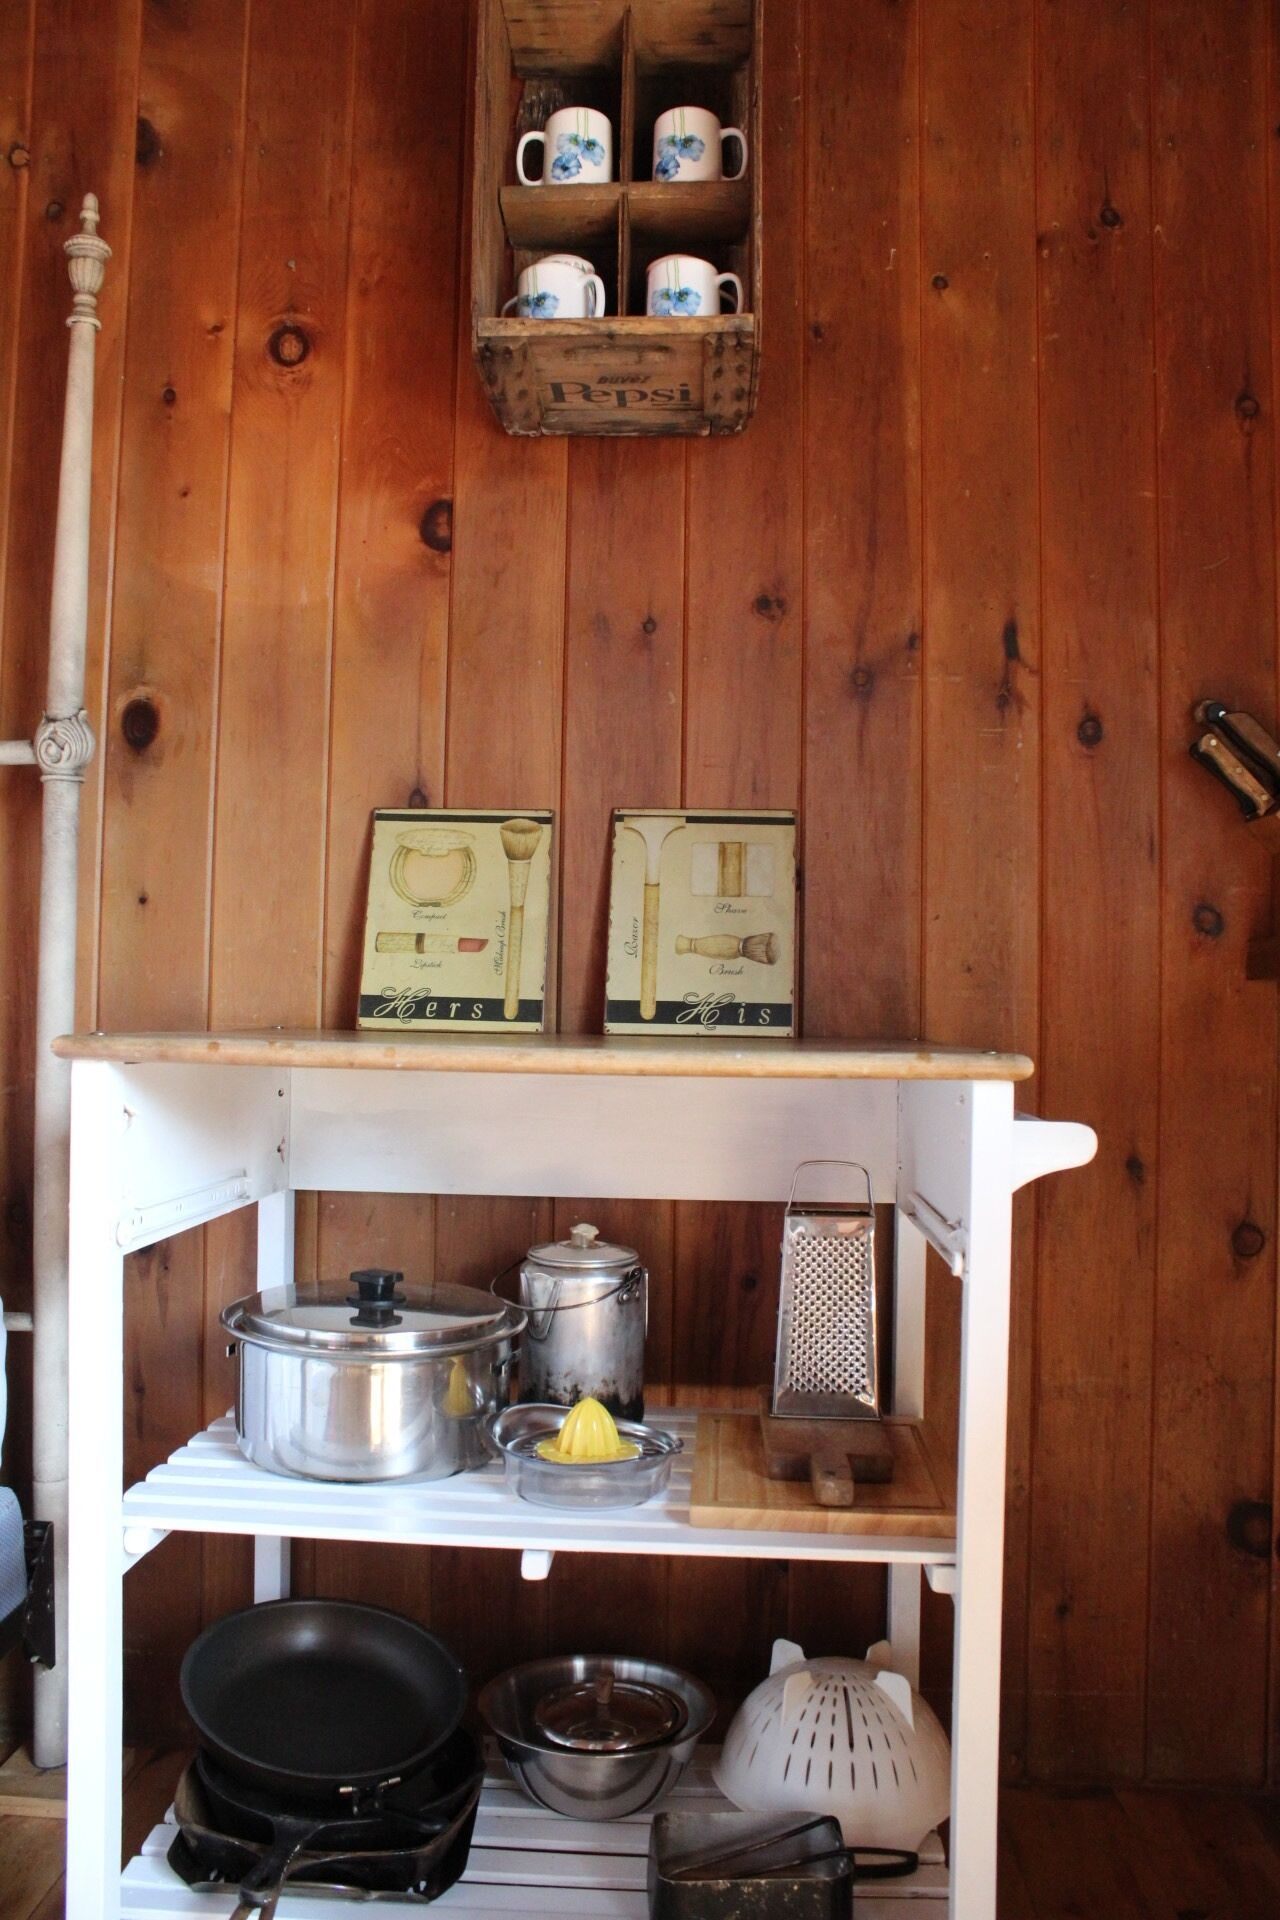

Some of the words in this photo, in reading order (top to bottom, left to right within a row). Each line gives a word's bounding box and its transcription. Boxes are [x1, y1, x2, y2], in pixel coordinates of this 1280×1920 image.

[548, 381, 692, 408] Pepsi
[411, 909, 448, 921] Compact
[623, 916, 639, 959] Razor
[409, 958, 443, 970] Lipstick
[709, 963, 744, 976] Brush
[373, 986, 484, 1024] Hers
[675, 992, 772, 1031] His
